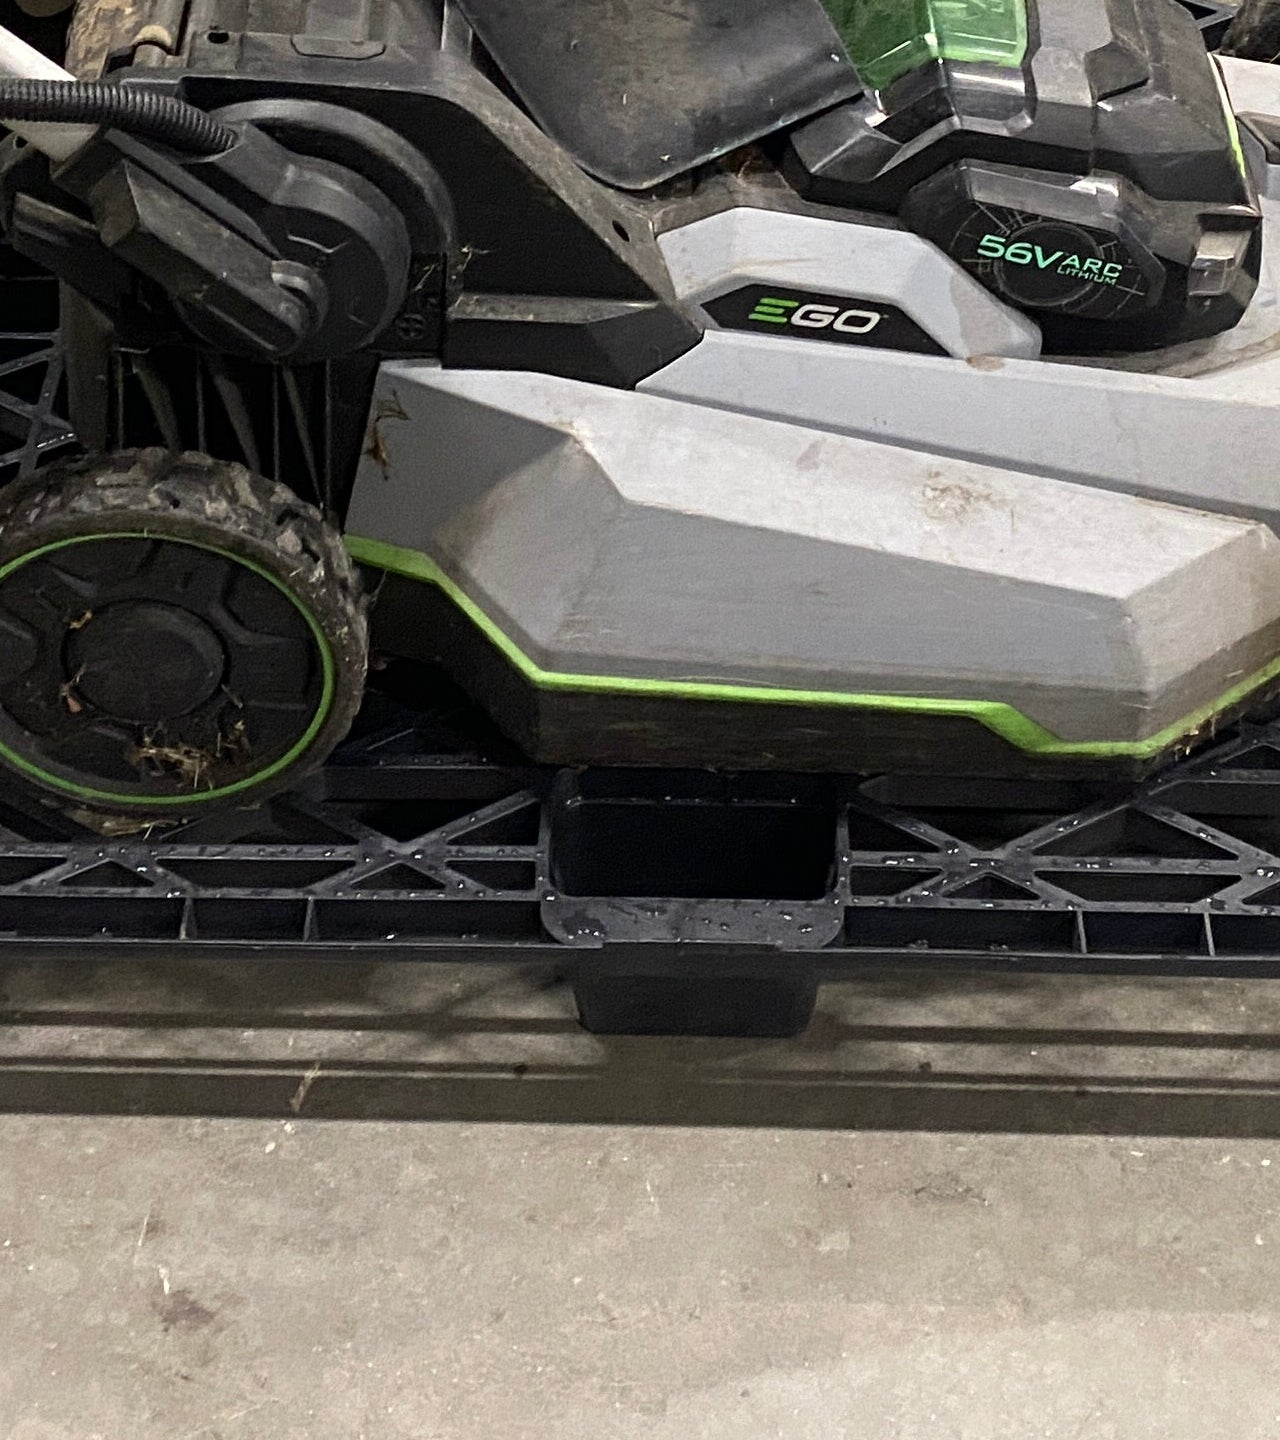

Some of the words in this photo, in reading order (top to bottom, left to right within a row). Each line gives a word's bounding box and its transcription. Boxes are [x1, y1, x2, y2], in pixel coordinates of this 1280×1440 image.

[977, 234, 1064, 269] 56V
[1058, 254, 1123, 278] ARC
[1056, 263, 1117, 286] LITHIUM
[748, 297, 881, 335] EGO
